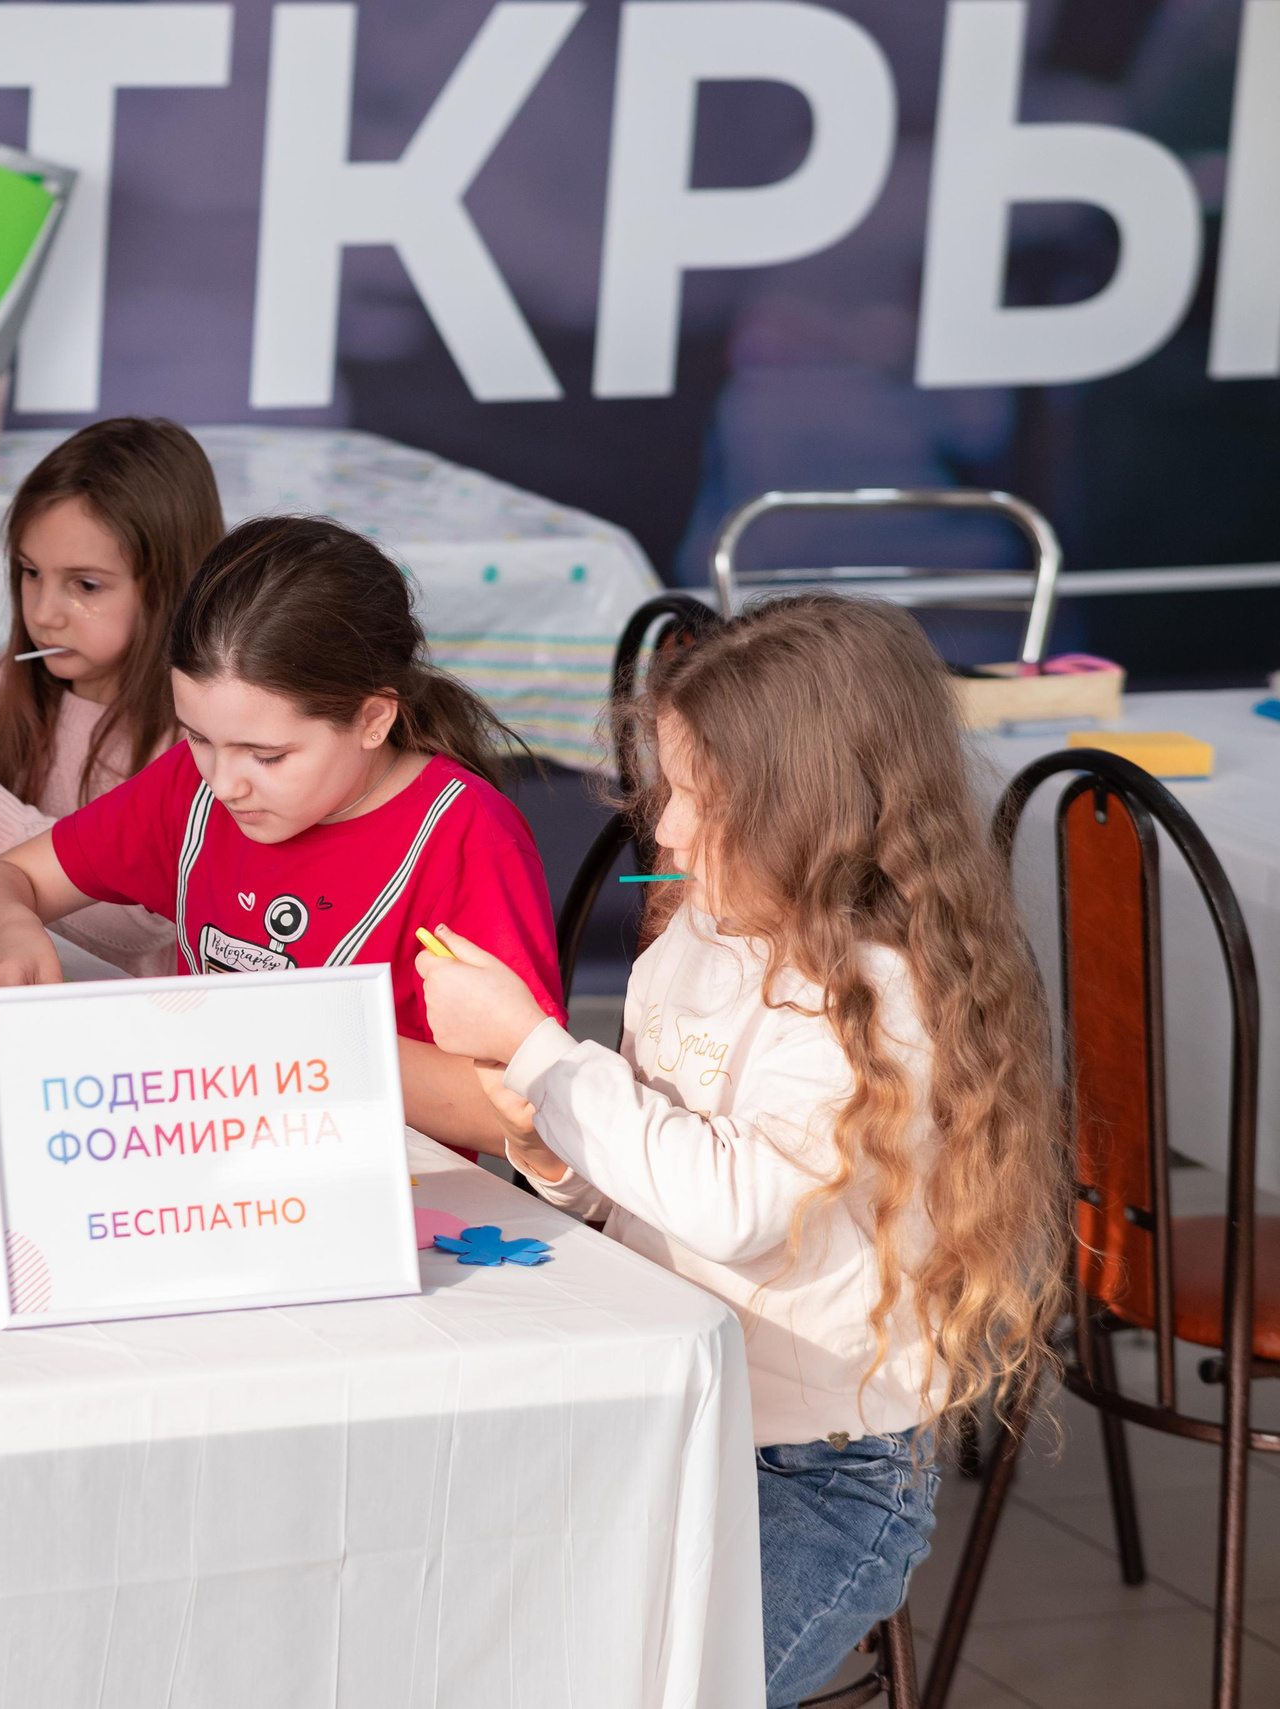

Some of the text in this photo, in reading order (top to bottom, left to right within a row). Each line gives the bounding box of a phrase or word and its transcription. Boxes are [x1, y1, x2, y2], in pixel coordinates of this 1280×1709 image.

[211, 932, 281, 972] Photography
[657, 1014, 732, 1086] Spring
[41, 1058, 331, 1113] ПОДЕЛКИ ИЗ
[46, 1110, 343, 1165] ФОАМИРАНА
[87, 1196, 307, 1240] БЕСПЛАТНО
